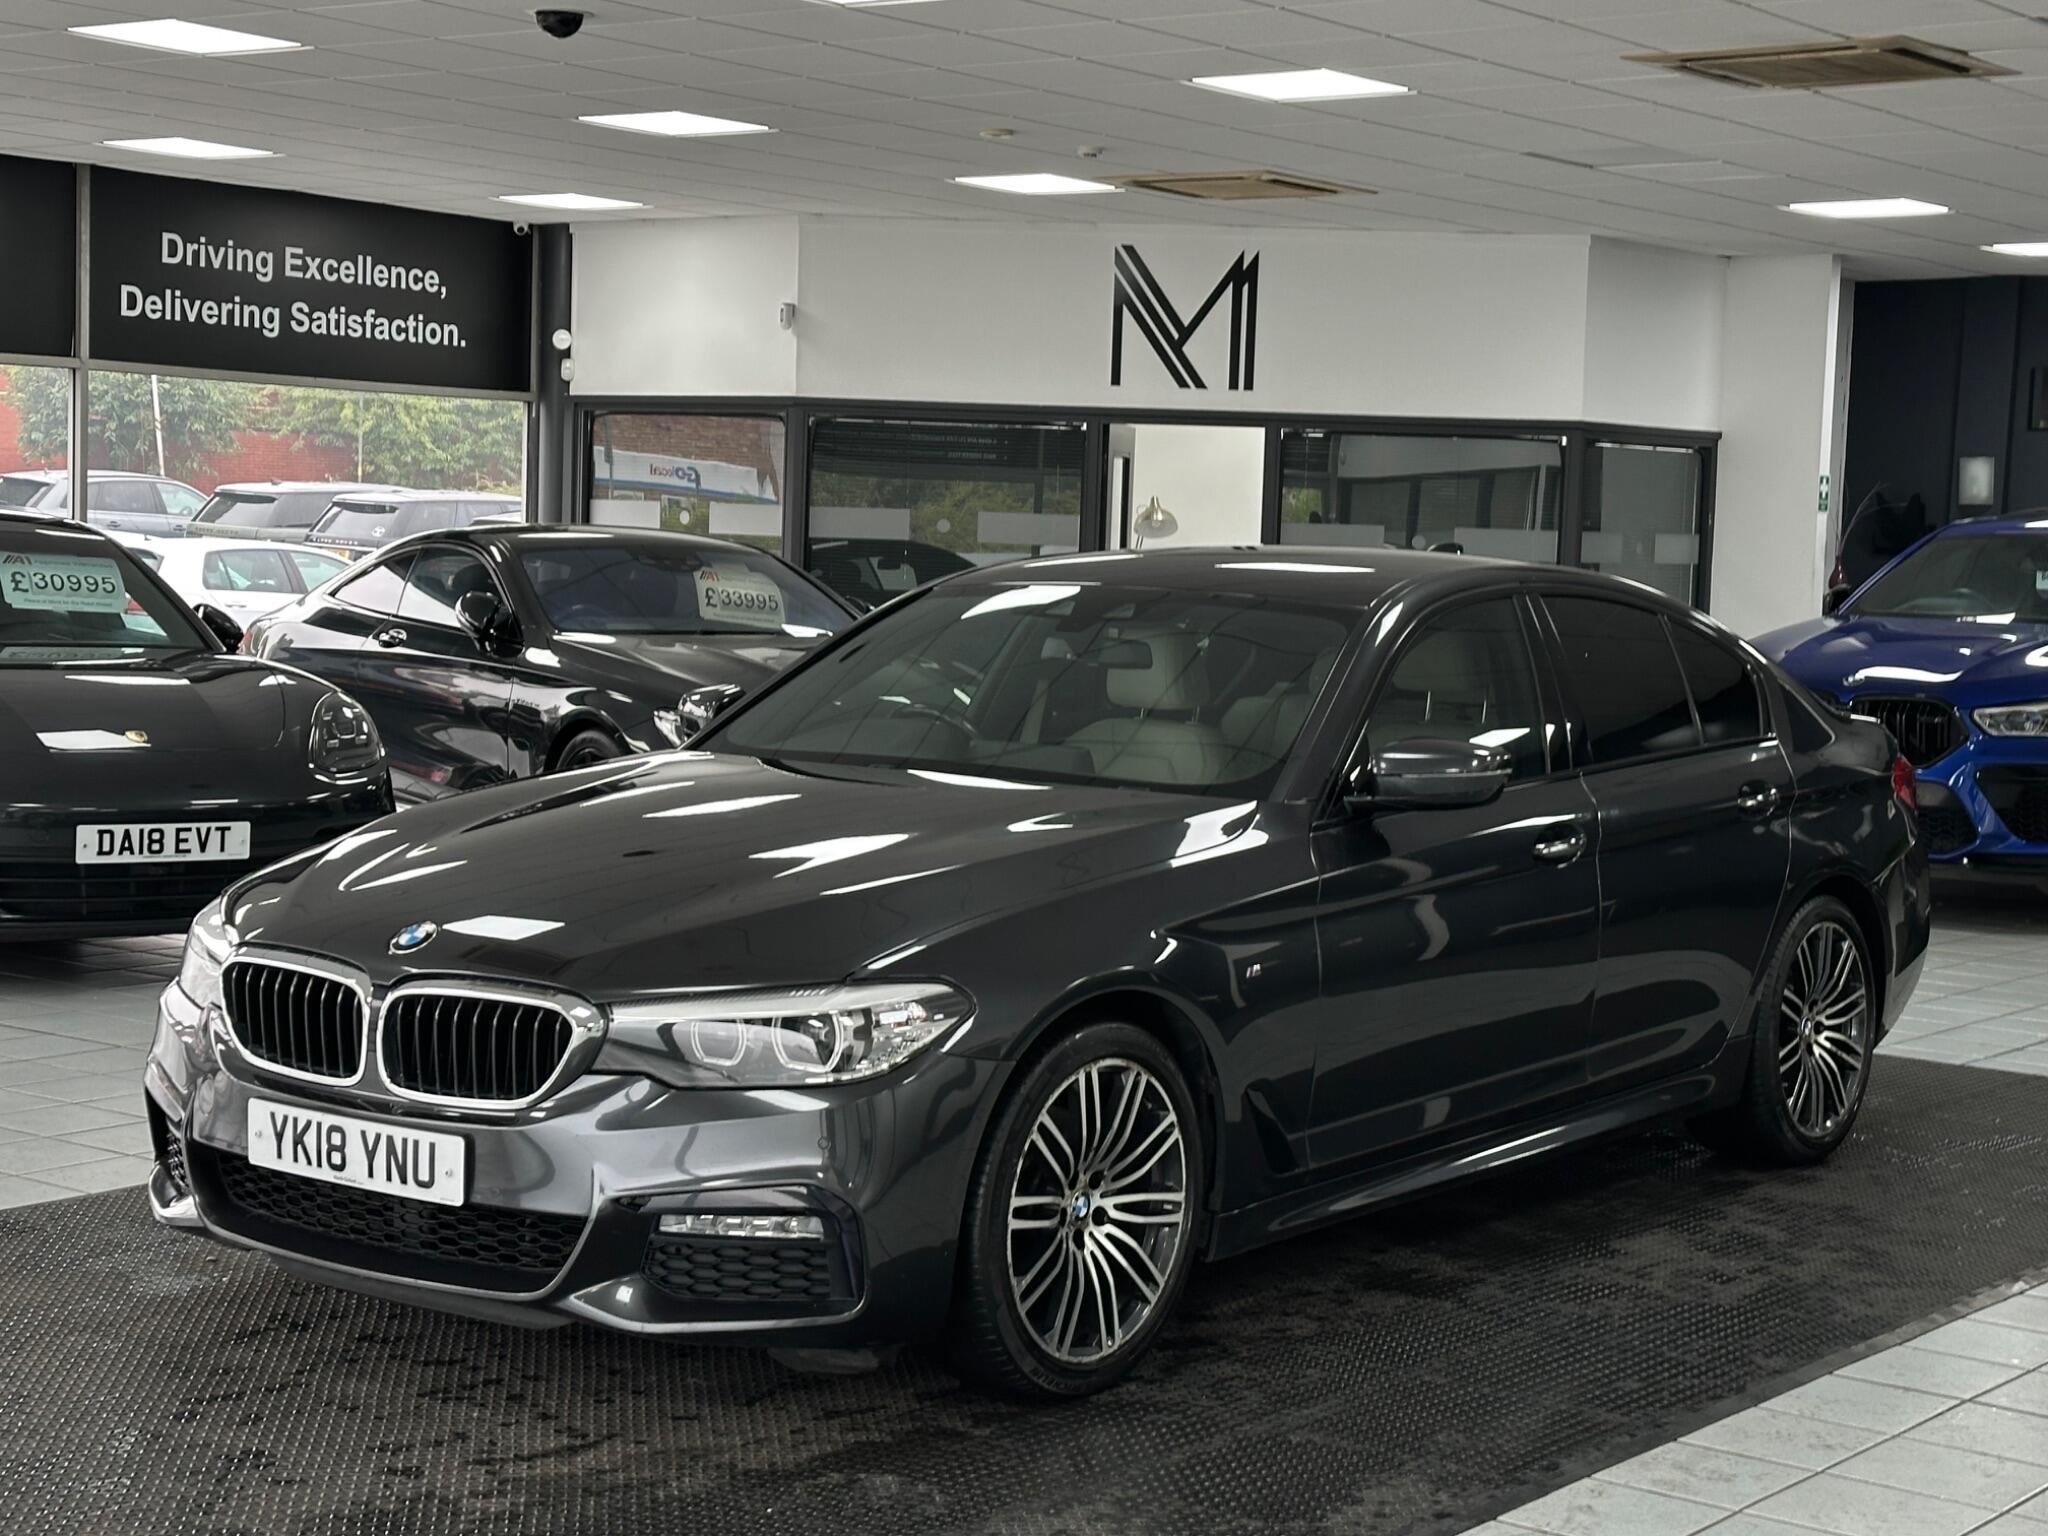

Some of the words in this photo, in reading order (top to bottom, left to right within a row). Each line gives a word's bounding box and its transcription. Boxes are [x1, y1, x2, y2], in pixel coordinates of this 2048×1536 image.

[161, 231, 274, 283] Driving
[284, 245, 447, 300] Excellence,
[120, 283, 280, 338] Delivering
[289, 300, 467, 348] Satisfaction.
[10, 570, 116, 594] £30995
[705, 587, 779, 611] £33995
[96, 827, 165, 856] DA18
[174, 825, 232, 854] EVT
[269, 1111, 347, 1172] YK18
[360, 1129, 436, 1189] YNU
